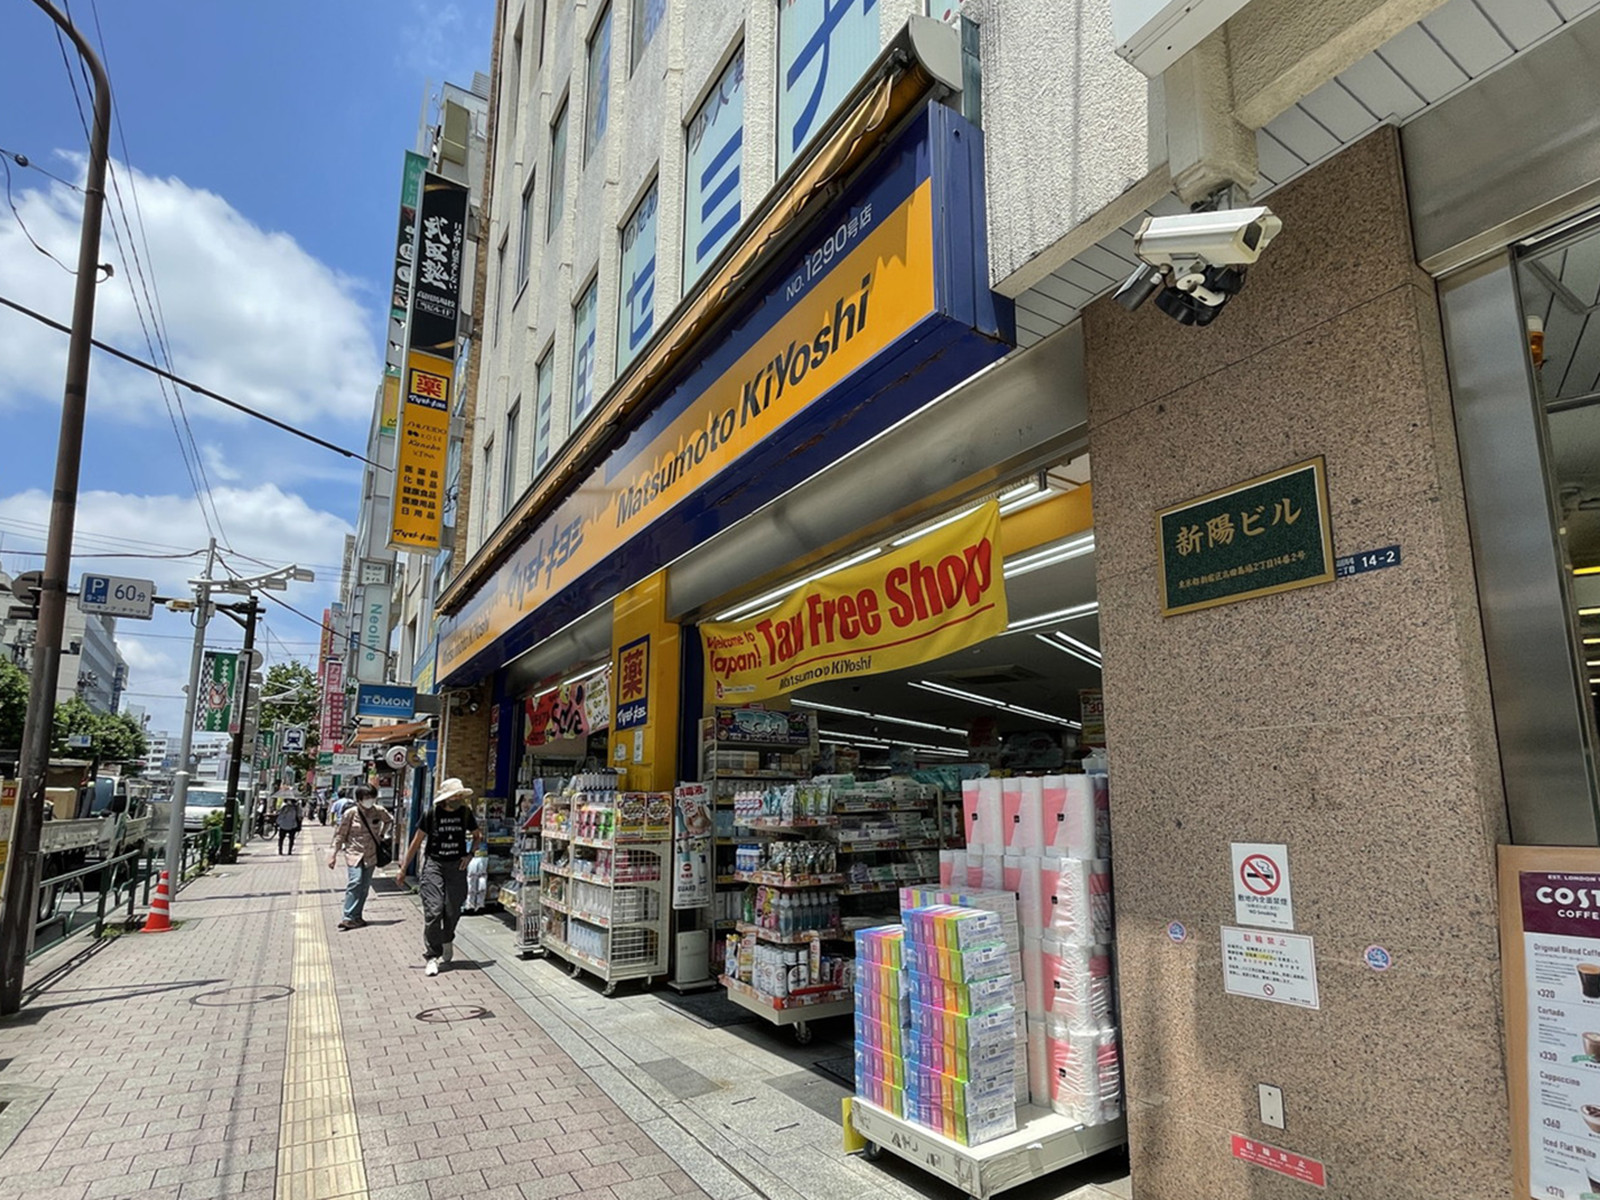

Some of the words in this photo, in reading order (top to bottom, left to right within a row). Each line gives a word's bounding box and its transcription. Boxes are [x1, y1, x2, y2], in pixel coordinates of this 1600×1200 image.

[420, 215, 450, 290] 武田塾
[416, 374, 442, 398] 薬
[616, 408, 736, 529] Matsumoto
[740, 272, 872, 430] KiYoshi
[1175, 498, 1302, 557] 新陽ビル
[1361, 550, 1396, 568] 14-2
[92, 579, 104, 593] P
[114, 584, 146, 603] 60分
[806, 588, 882, 647] Free
[885, 537, 992, 628] Shop
[707, 635, 744, 649] Welcome
[744, 631, 756, 644] to
[622, 649, 644, 701] 薬
[831, 655, 872, 675] KiYoshi
[1559, 1139, 1574, 1152] Flat
[1575, 1143, 1597, 1159] White
